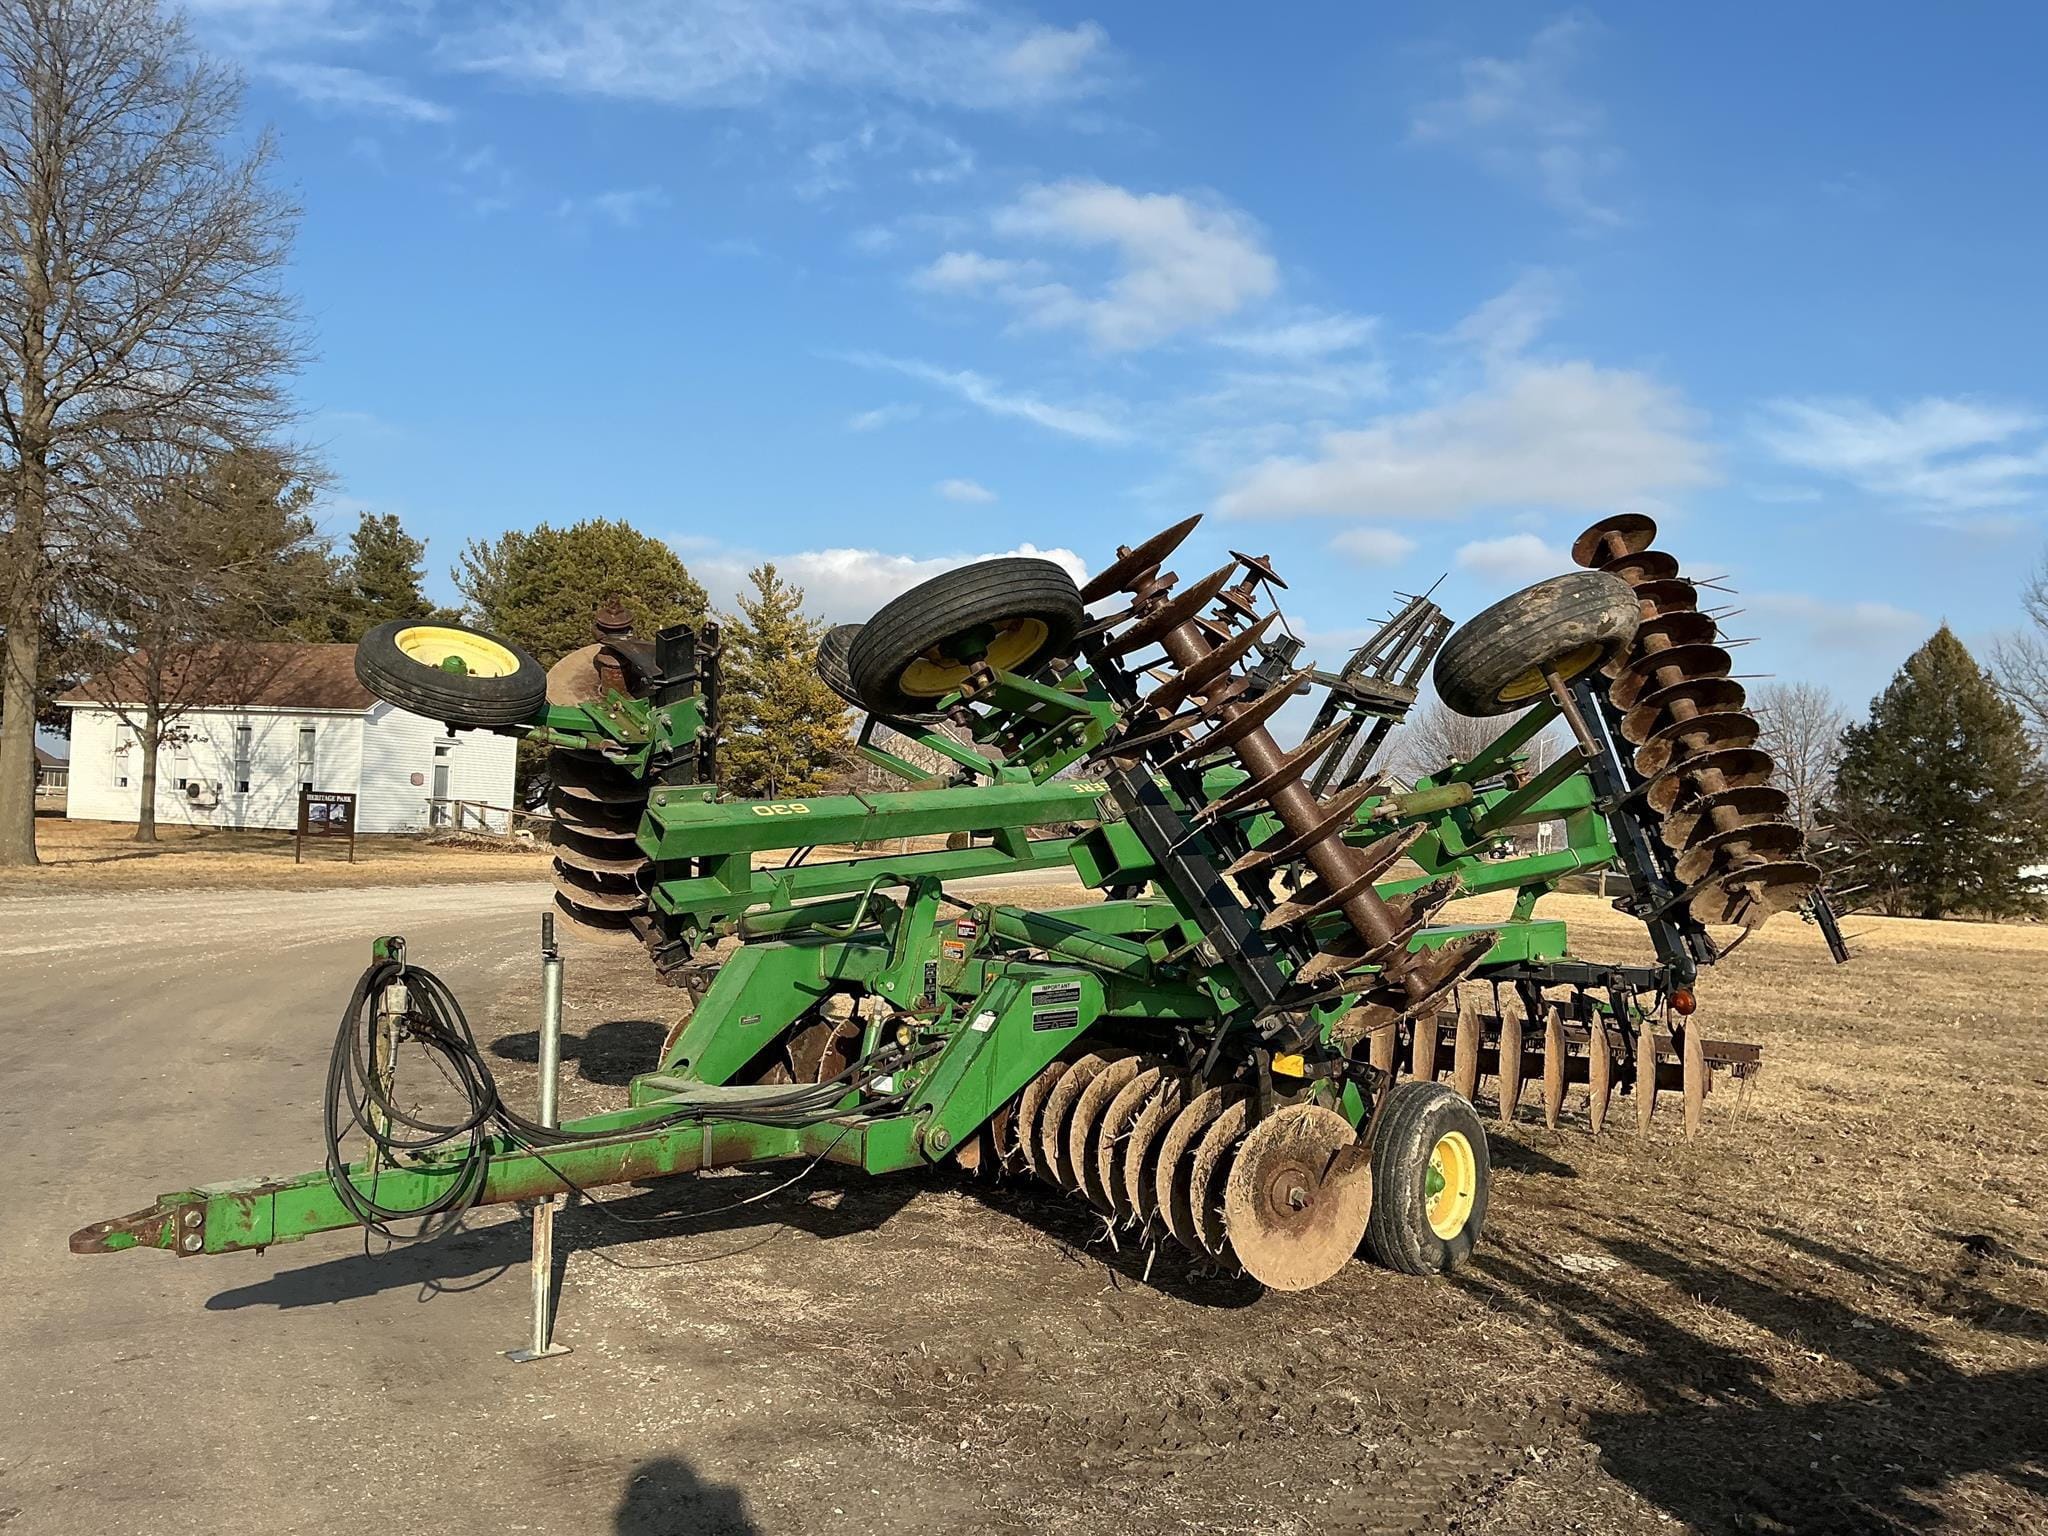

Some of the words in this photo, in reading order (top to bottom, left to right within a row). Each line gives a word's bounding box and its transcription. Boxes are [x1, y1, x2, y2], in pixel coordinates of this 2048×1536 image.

[1068, 782, 1111, 793] EERE
[751, 803, 811, 816] 630
[1041, 983, 1071, 991] IMPORTANT
